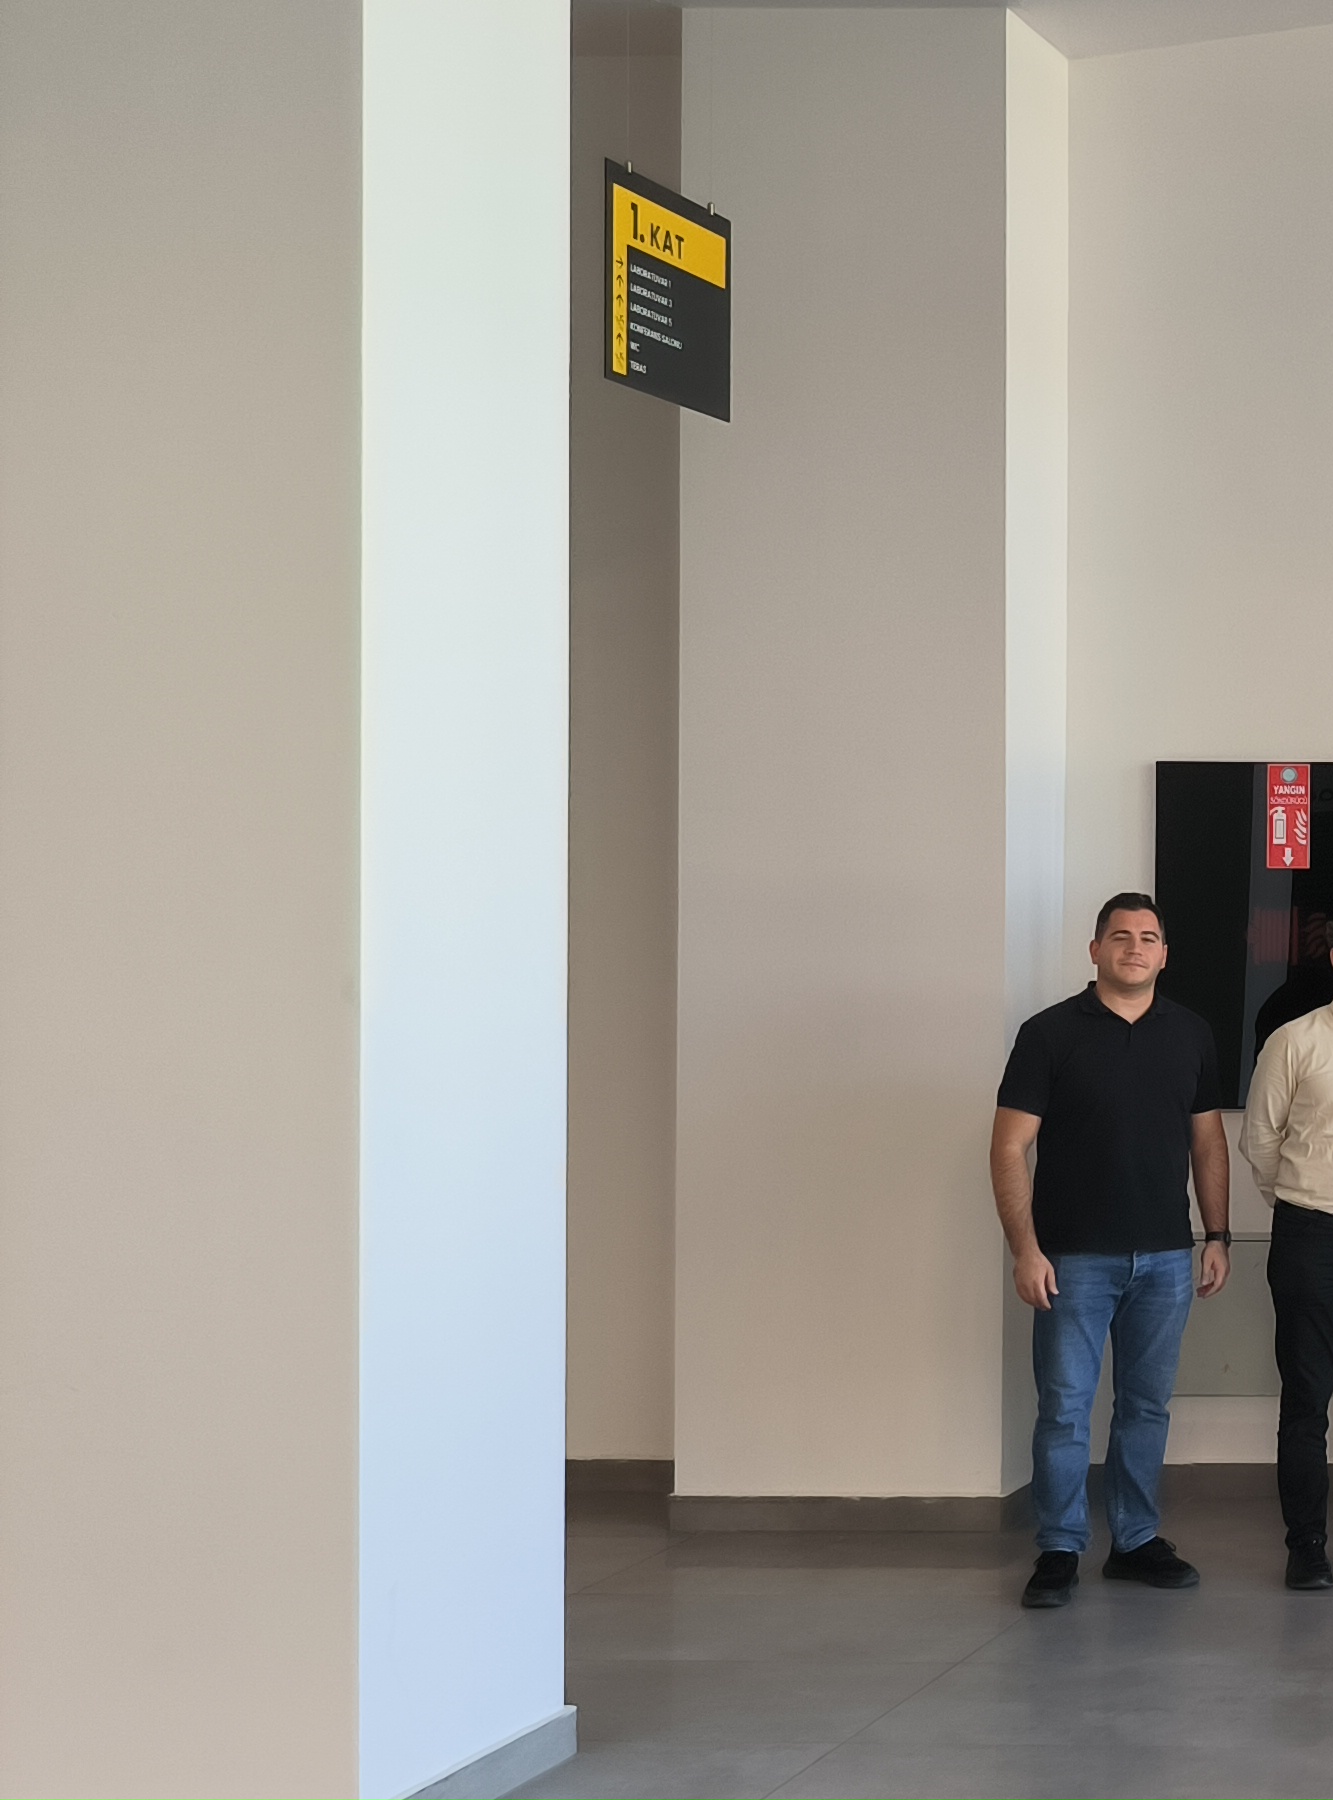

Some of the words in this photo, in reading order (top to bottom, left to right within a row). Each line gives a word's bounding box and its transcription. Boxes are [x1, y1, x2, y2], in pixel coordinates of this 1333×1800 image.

[631, 202, 645, 243] 1.
[651, 223, 685, 260] KAT
[1273, 785, 1306, 795] YANGIN
